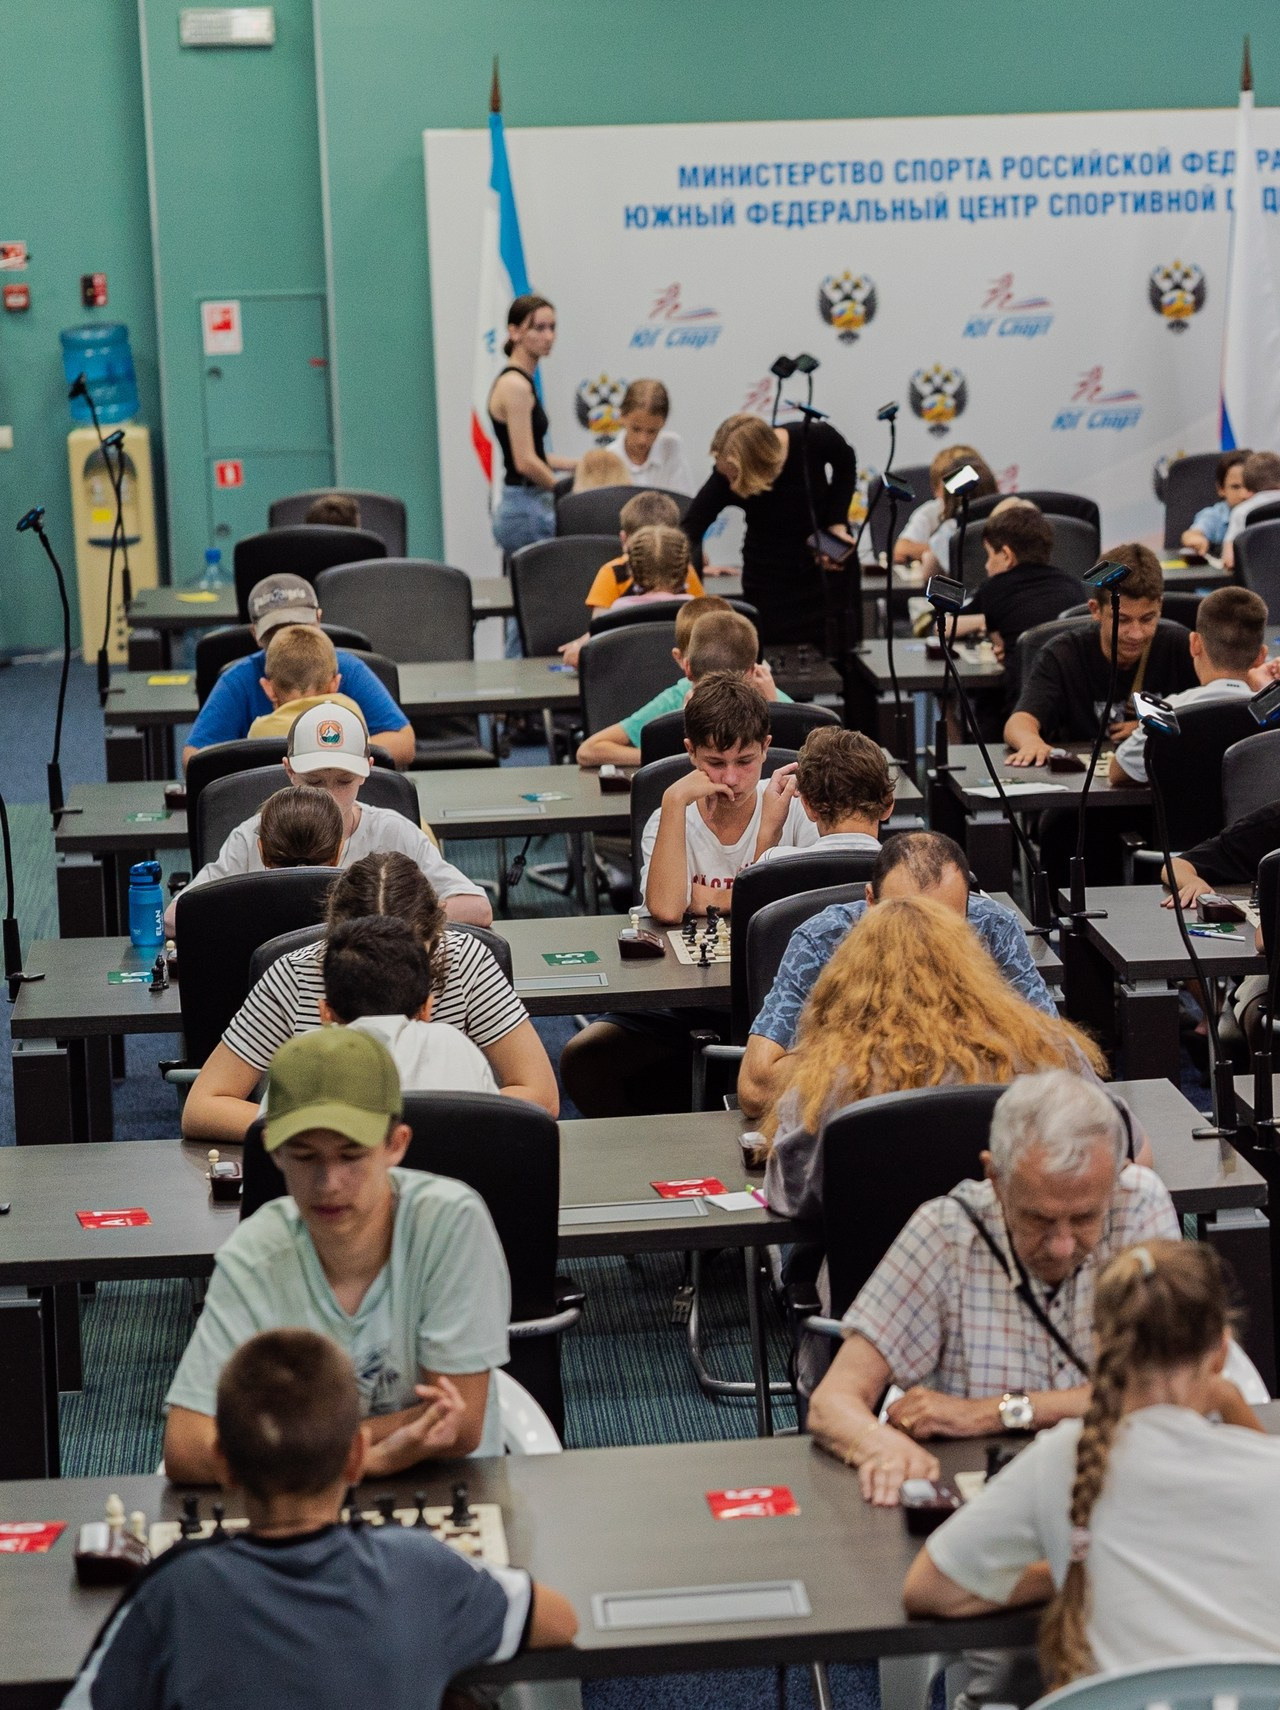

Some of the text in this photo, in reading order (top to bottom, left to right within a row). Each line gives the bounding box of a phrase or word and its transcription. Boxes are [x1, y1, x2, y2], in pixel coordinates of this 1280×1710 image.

[678, 158, 885, 189] МИНИСТЕРСТВО
[893, 156, 992, 185] СПОРТА
[1002, 147, 1172, 180] РОССИЙСКОЙ
[624, 196, 736, 229] ЮЖНЫЙ
[745, 191, 949, 229] ФЕДЕРАЛЬНЫЙ
[958, 193, 1038, 224] ЦЕНТР
[1049, 184, 1216, 217] СПОРТИВНОЙ
